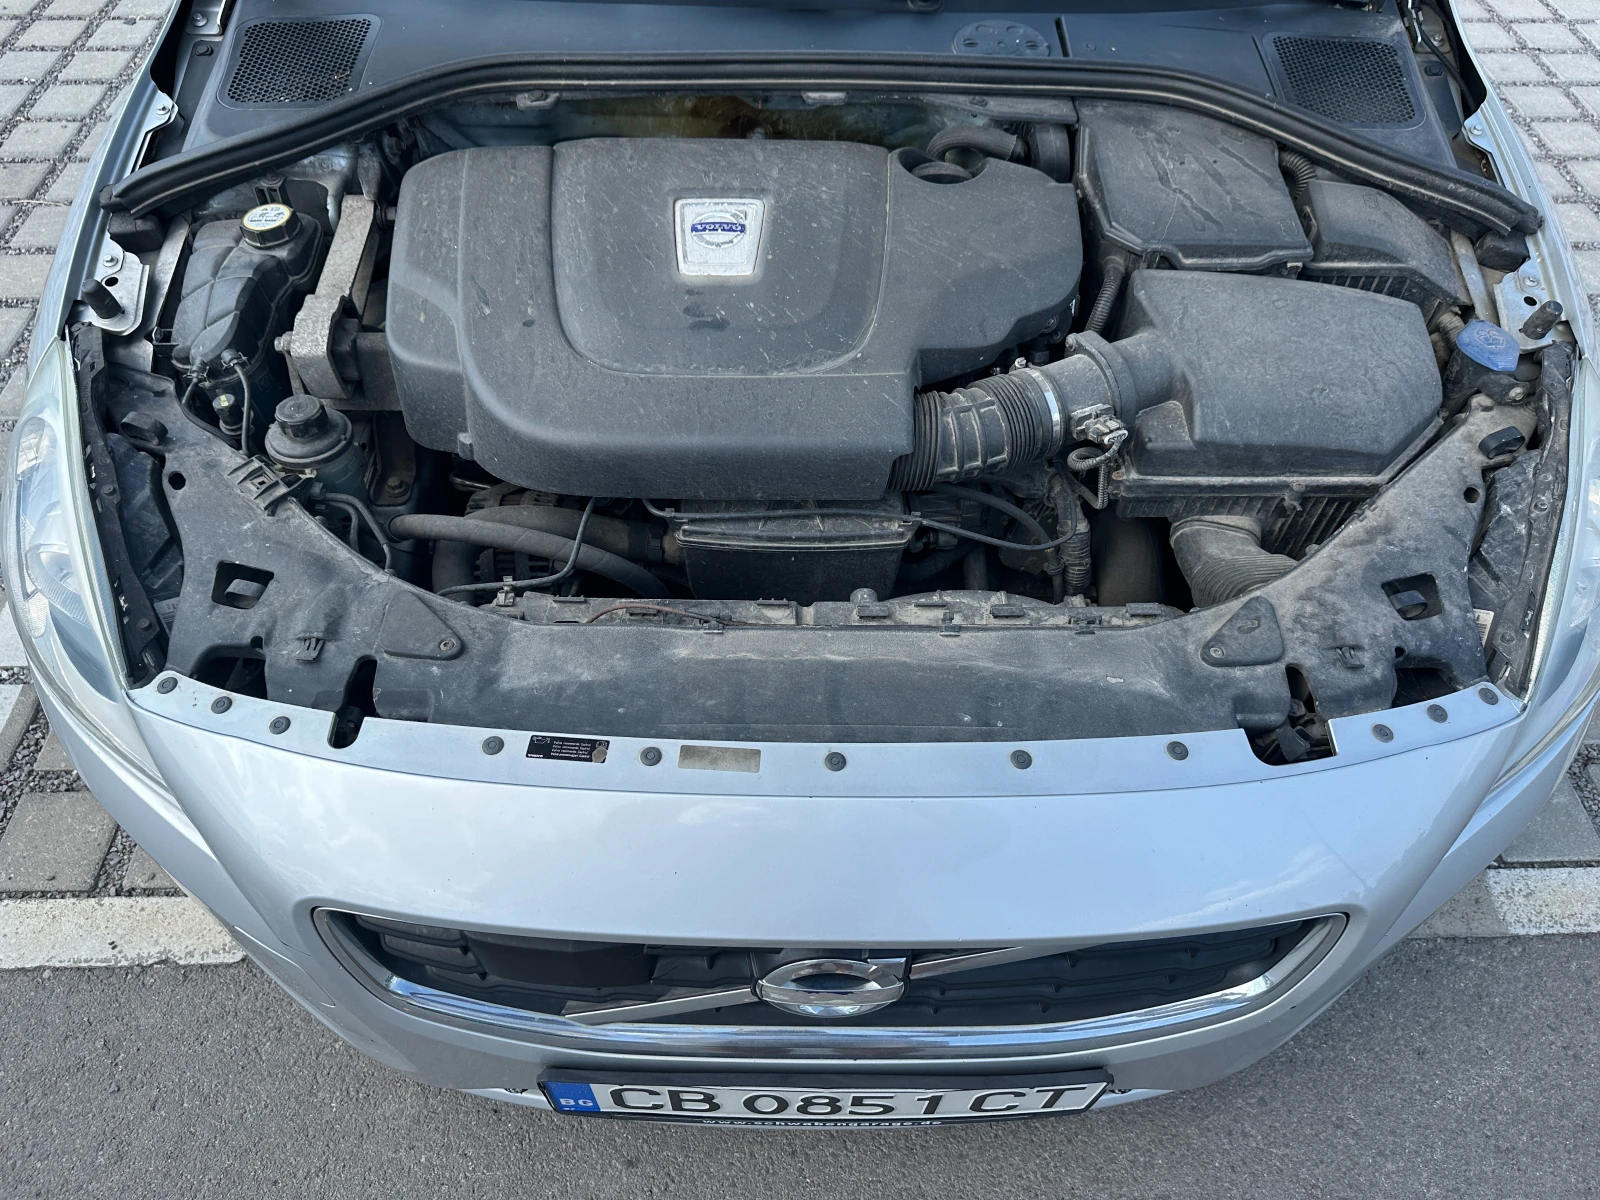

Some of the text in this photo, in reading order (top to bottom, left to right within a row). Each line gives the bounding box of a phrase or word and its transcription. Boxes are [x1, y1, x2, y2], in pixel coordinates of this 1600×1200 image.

[559, 1098, 593, 1106] BG
[609, 1086, 1087, 1115] CB 0851 CT
